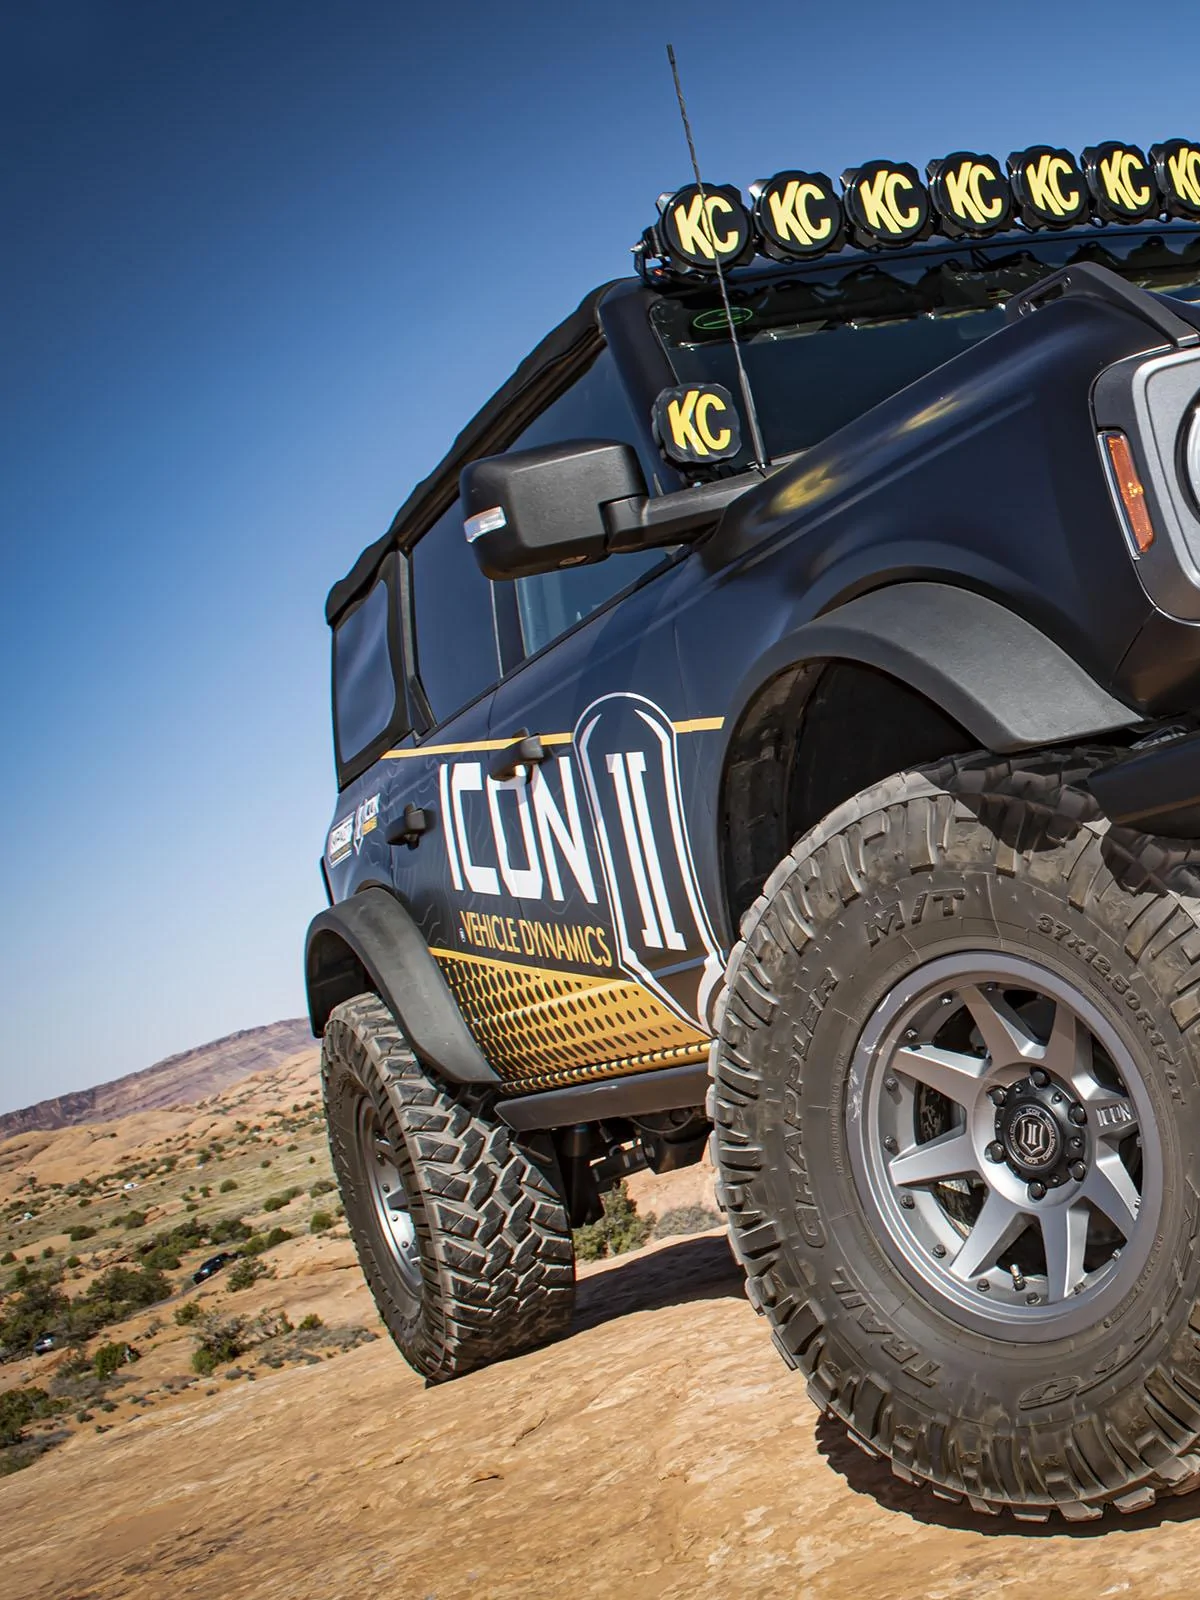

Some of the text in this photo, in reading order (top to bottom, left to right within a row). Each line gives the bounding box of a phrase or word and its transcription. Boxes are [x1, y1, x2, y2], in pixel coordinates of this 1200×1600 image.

[769, 180, 832, 245] KC
[859, 169, 919, 234] KC
[945, 160, 1002, 224] KC
[1026, 155, 1079, 215] KC
[1100, 150, 1150, 210] KC
[674, 194, 739, 260] KC
[667, 390, 731, 456] KC
[440, 757, 598, 904] ICON
[460, 910, 613, 968] VEHICLE DYNAMICS
[1095, 1101, 1132, 1127] ICON
[831, 1266, 941, 1389] TRAIL
